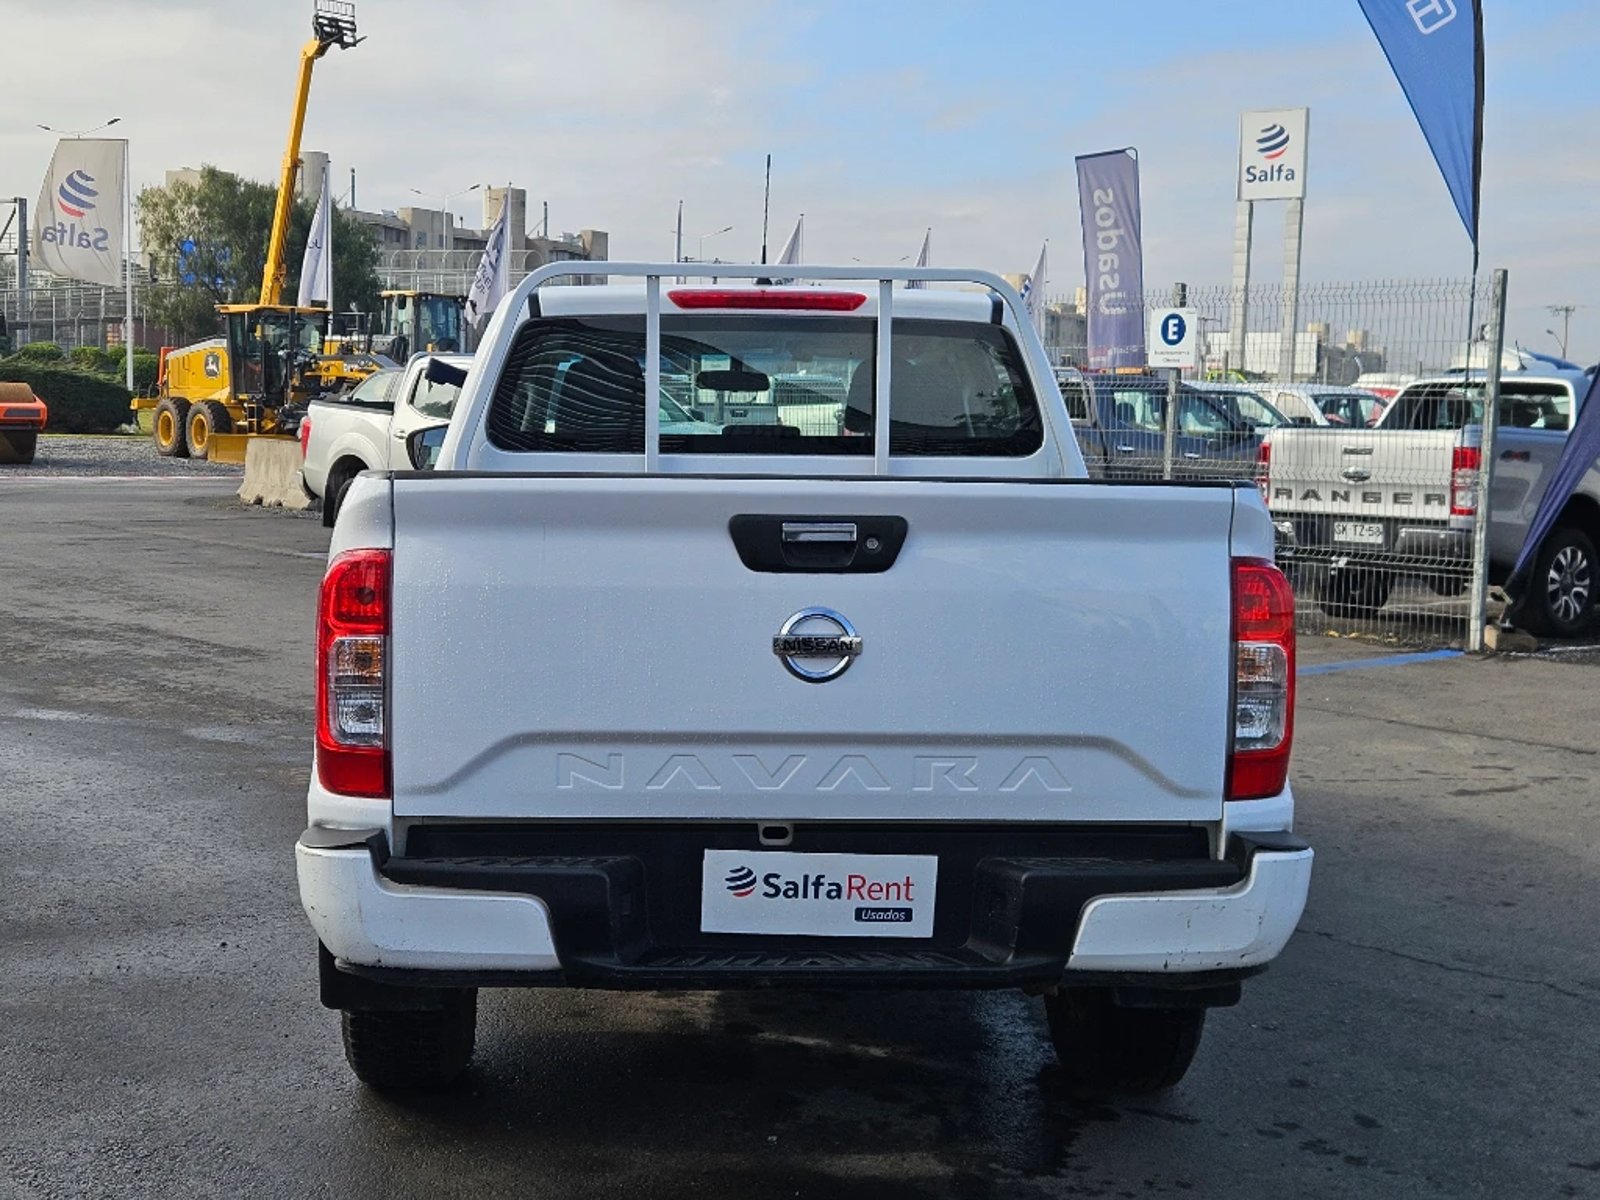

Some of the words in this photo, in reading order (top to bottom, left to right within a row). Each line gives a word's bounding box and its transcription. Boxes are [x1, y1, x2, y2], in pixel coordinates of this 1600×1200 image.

[1245, 163, 1295, 183] Salfa
[1167, 318, 1179, 340] E
[1273, 487, 1446, 505] RANGER
[783, 639, 853, 651] NISSAN
[556, 753, 1073, 792] NAVARA
[762, 872, 914, 901] SalfaRent
[861, 909, 907, 921] Usados
